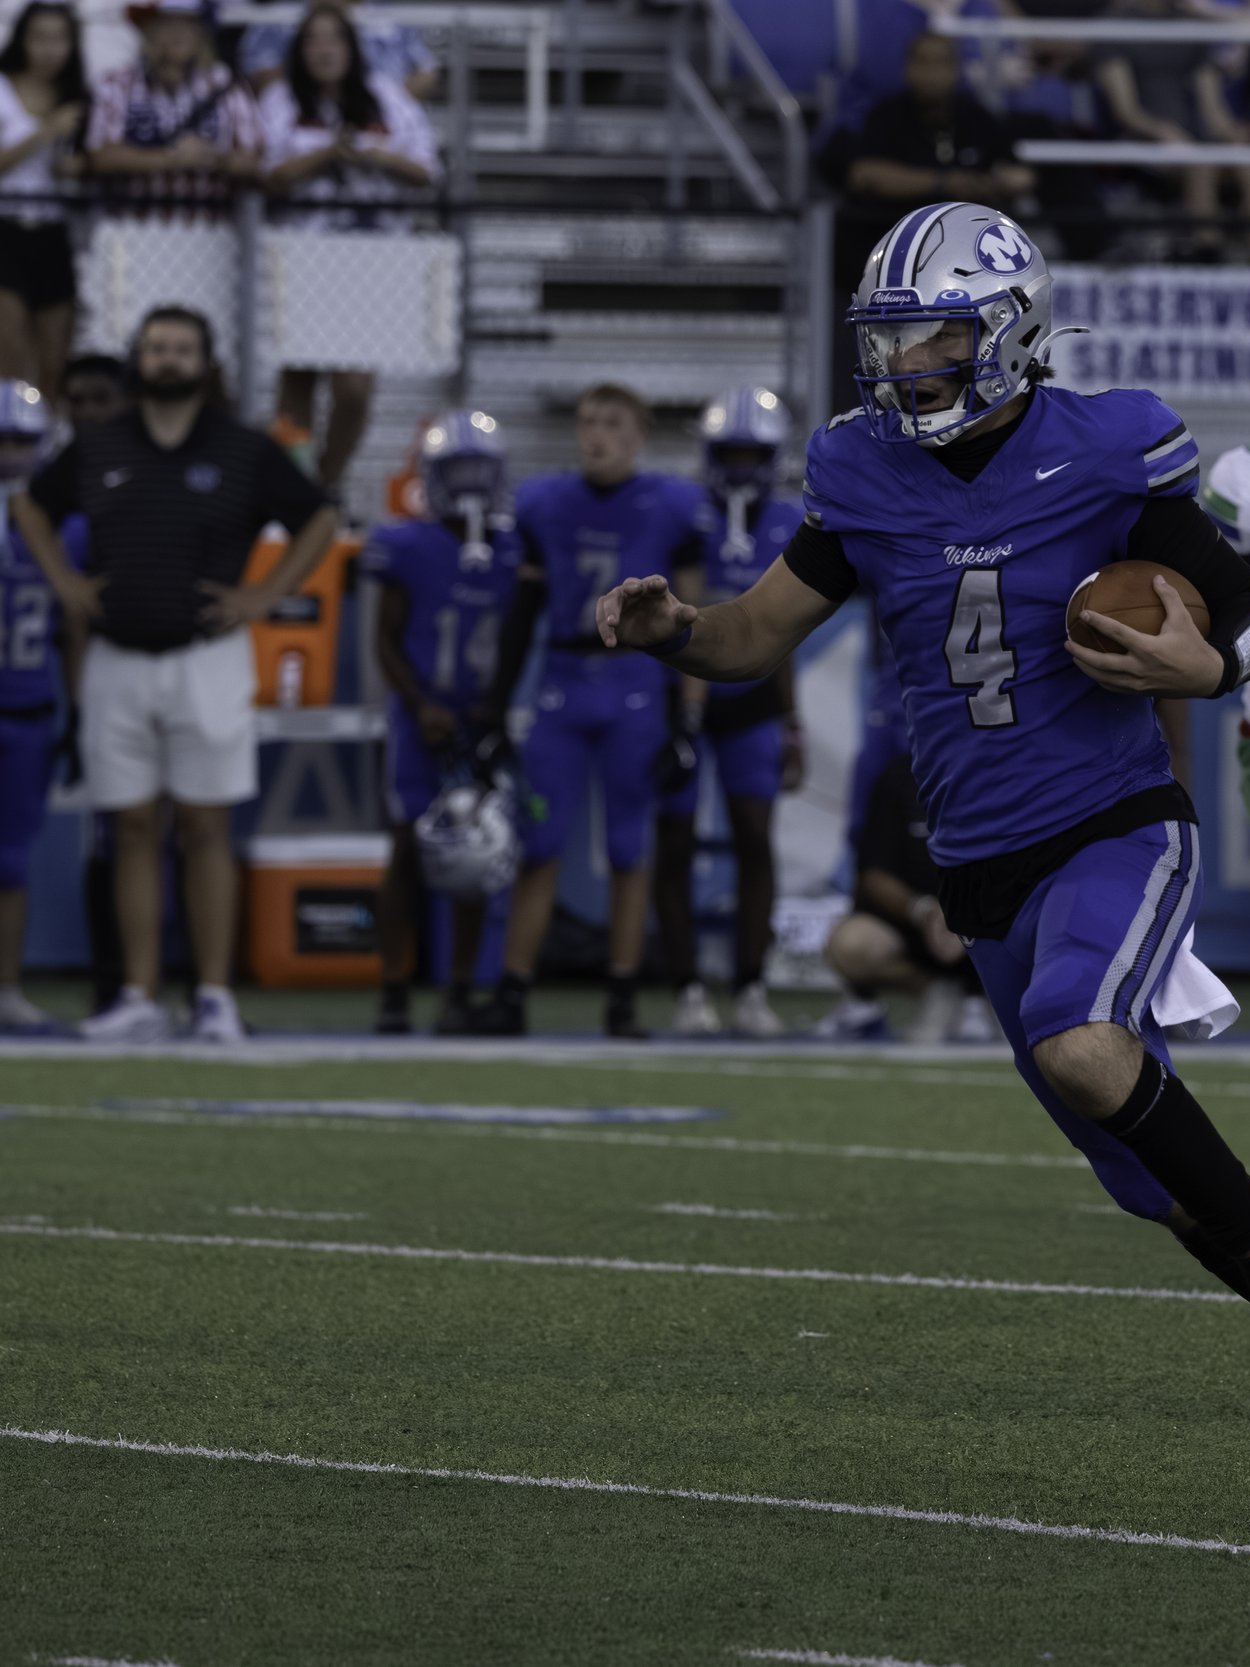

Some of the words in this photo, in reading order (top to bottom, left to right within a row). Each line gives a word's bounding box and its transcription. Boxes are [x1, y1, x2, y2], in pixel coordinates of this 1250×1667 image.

[980, 225, 1032, 272] M
[873, 290, 912, 305] Vikings
[943, 543, 1014, 565] Vikings
[943, 566, 1019, 728] 4
